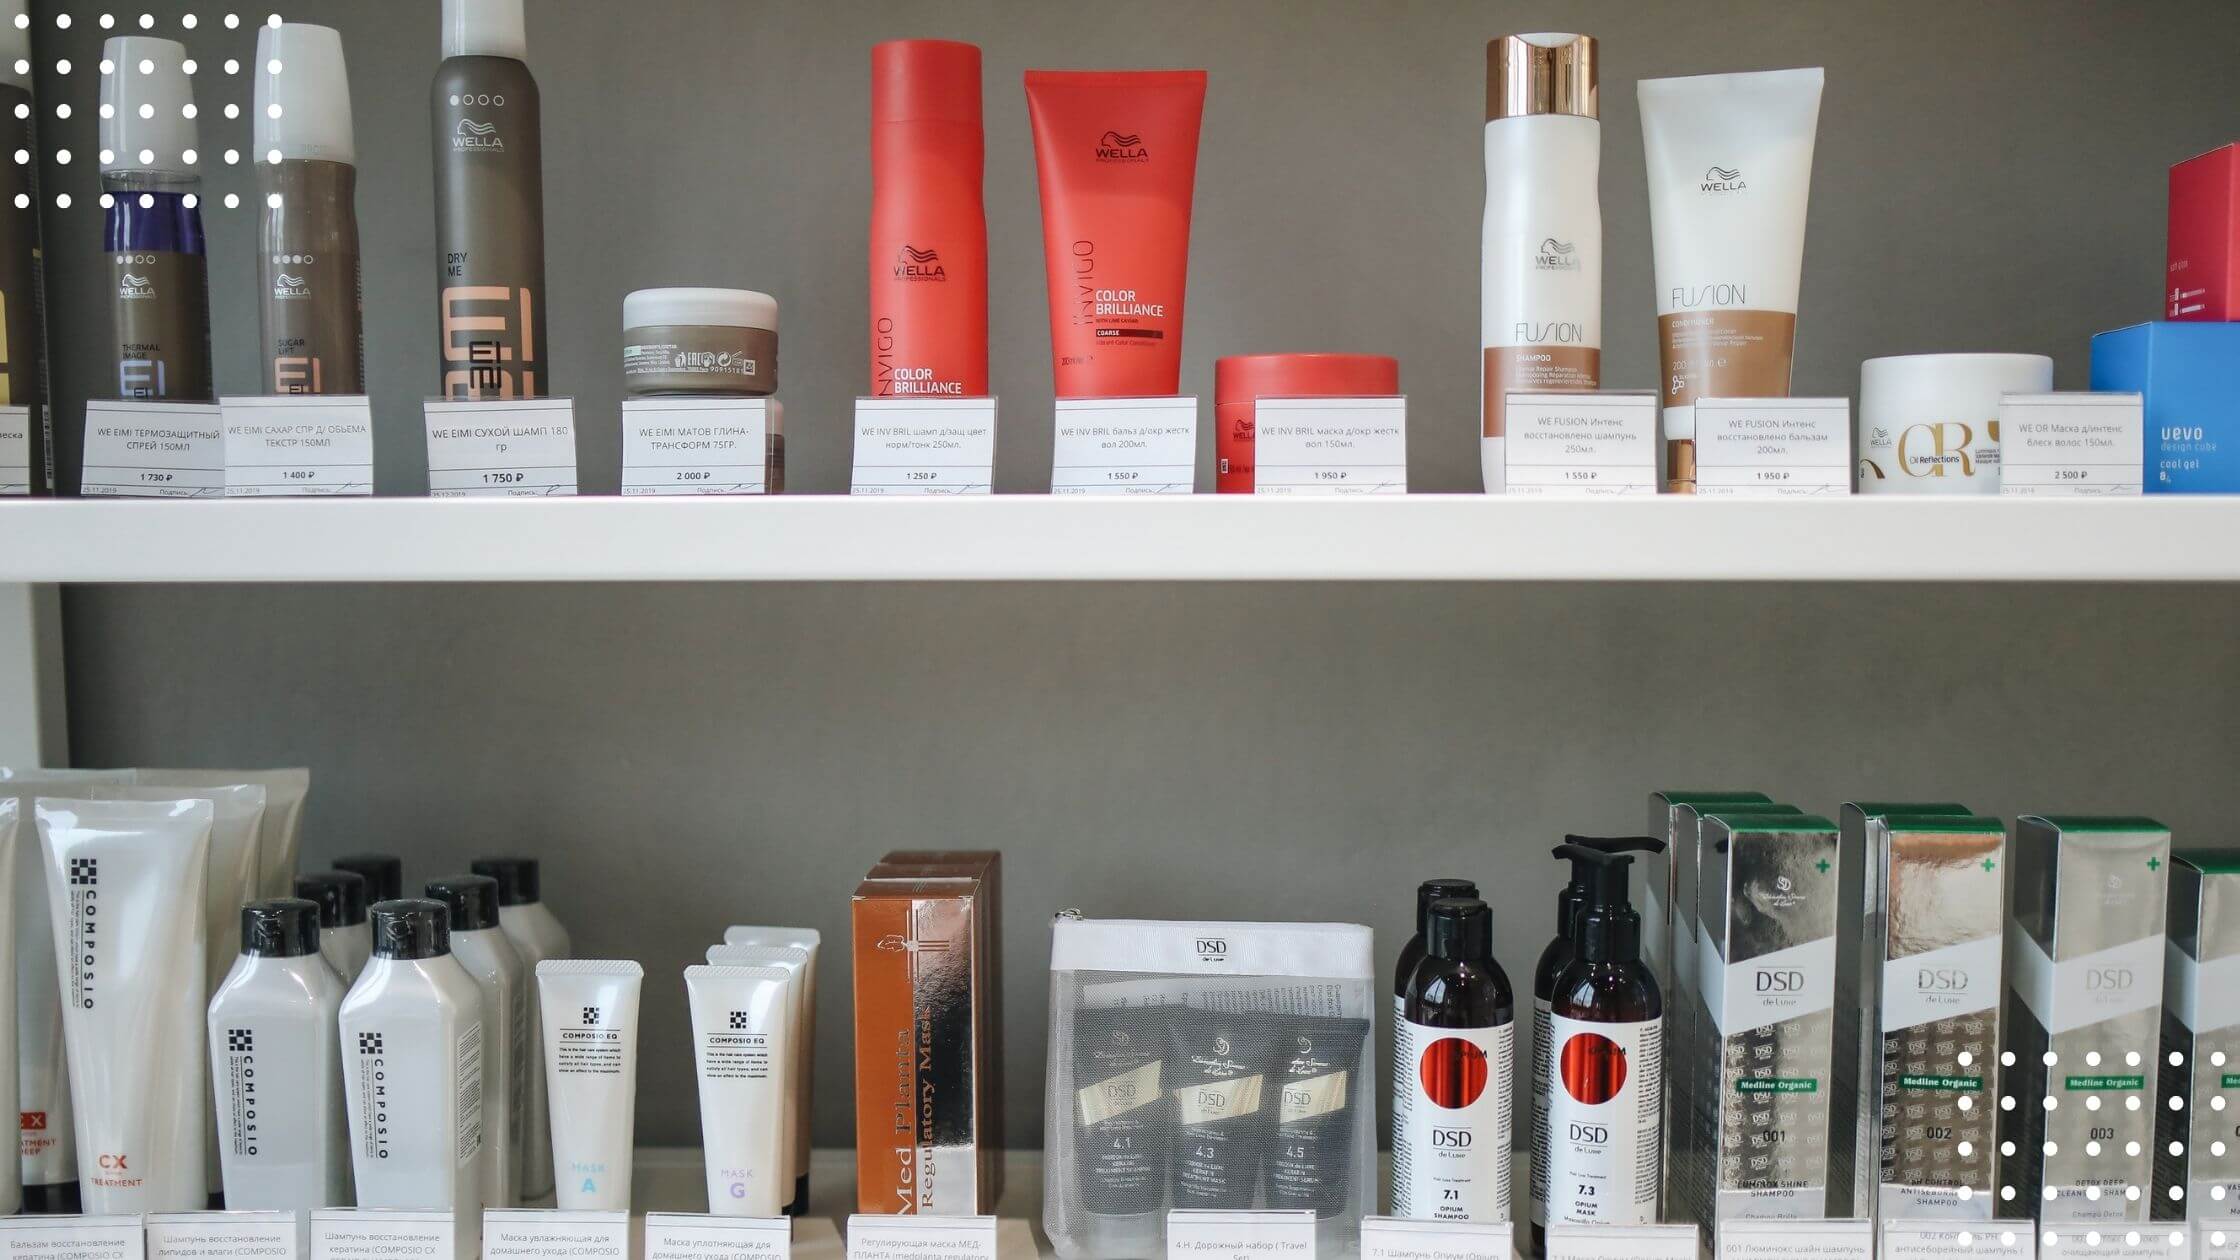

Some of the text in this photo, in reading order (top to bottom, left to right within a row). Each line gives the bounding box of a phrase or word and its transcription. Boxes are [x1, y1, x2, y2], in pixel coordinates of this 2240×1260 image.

[453, 137, 503, 147] WELLA
[1096, 149, 1148, 158] WELLA
[1700, 182, 1746, 191] WELLA
[447, 253, 467, 264] DRY
[448, 265, 462, 277] ME
[894, 266, 945, 276] WELLA
[120, 287, 155, 295] WELLA
[1096, 290, 1136, 302] COLOR
[1672, 284, 1746, 309] FUSION
[1096, 304, 1164, 317] BRILLIANCE
[1515, 322, 1582, 343] FUSION
[878, 317, 893, 396] NVIGO
[895, 369, 932, 380] COLOR
[895, 383, 961, 394] BRILLIANCE
[1537, 418, 1623, 426] WE FUSION Интенс
[1729, 420, 1815, 428] WE FUSION Интенс
[98, 428, 220, 440] WE EIMI ТЕРМОЗАЩИТНЫЙ
[265, 426, 293, 434] САХАР
[296, 426, 313, 434] СПР
[315, 426, 326, 435] Д/
[432, 426, 568, 438] WE EIMI СУХОЙ ШАМП 180
[639, 428, 749, 437] WE EIMI МАТОВ ГЛИНА-
[862, 428, 874, 436] WE
[939, 427, 965, 437] д/защ
[966, 429, 987, 437] цвет
[1061, 428, 1074, 436] WE
[1076, 428, 1091, 436] INV
[1112, 427, 1137, 435] бальз
[1139, 428, 1163, 437] д/окр
[1262, 427, 1275, 435] WE
[1278, 427, 1292, 435] INV
[1295, 427, 1314, 435] BRIL
[1346, 427, 1371, 437] д/окр
[2051, 424, 2079, 432] Маска
[2081, 424, 2122, 433] д/интенс
[2161, 425, 2203, 440] uevo
[1594, 433, 1637, 442] шампунь
[1717, 433, 1828, 441] восстановлено бальзам
[126, 441, 190, 451] СПРЕЙ 150МЛ
[265, 439, 331, 447] ТЕКСТР 150МЛ
[496, 443, 507, 453] гр
[651, 440, 736, 450] ТРАНСФОРМ 75ГР.
[492, 473, 513, 482] 750
[516, 473, 524, 482] ₽
[684, 472, 701, 480] 000
[84, 890, 97, 1009] COMPOSIO
[1196, 939, 1226, 954] DSD
[1757, 972, 1803, 991] DSD
[1918, 969, 1968, 990] DSD
[2086, 969, 2133, 990] DSD
[896, 1028, 911, 1134] Planta
[1779, 1082, 1812, 1090] Organic
[1904, 1078, 1977, 1088] Medline Organic
[2070, 1078, 2139, 1089] Medline Organic
[1199, 1092, 1225, 1107] DSD
[1284, 1092, 1311, 1105] DSD
[244, 1056, 257, 1155] COMPOSIO
[374, 1059, 388, 1159] COMPOSIO
[1433, 1130, 1471, 1147] DSD
[1570, 1124, 1607, 1143] DSD
[1763, 1130, 1785, 1141] 001
[1927, 1127, 1951, 1139] 002
[2090, 1128, 2114, 1140] 003
[921, 1079, 936, 1208] Regulatory
[1114, 1138, 1131, 1149] 4.1
[1196, 1146, 1214, 1158] 4.3
[1287, 1146, 1304, 1158] 4.5
[99, 1155, 127, 1168] CX
[720, 1169, 753, 1177] MASK
[91, 1178, 143, 1187] TREATMENT
[582, 1179, 596, 1192] A
[731, 1183, 745, 1198] G
[1444, 1190, 1459, 1199] 7.1
[1578, 1185, 1595, 1195] 7.3
[164, 1236, 206, 1244] Шампунь
[325, 1233, 440, 1242] Шампунь восстановление
[530, 1235, 592, 1243] увлажняющая
[10, 1240, 125, 1249] Бальзам восстановление
[664, 1238, 690, 1246] Маска
[692, 1240, 753, 1249] уплотняющая
[862, 1238, 928, 1248] Регулирующая
[959, 1241, 981, 1249] МЕД-
[372, 1246, 422, 1254] (COMPOSIO
[542, 1248, 567, 1256] ухода
[569, 1247, 620, 1256] (COMPOSIO
